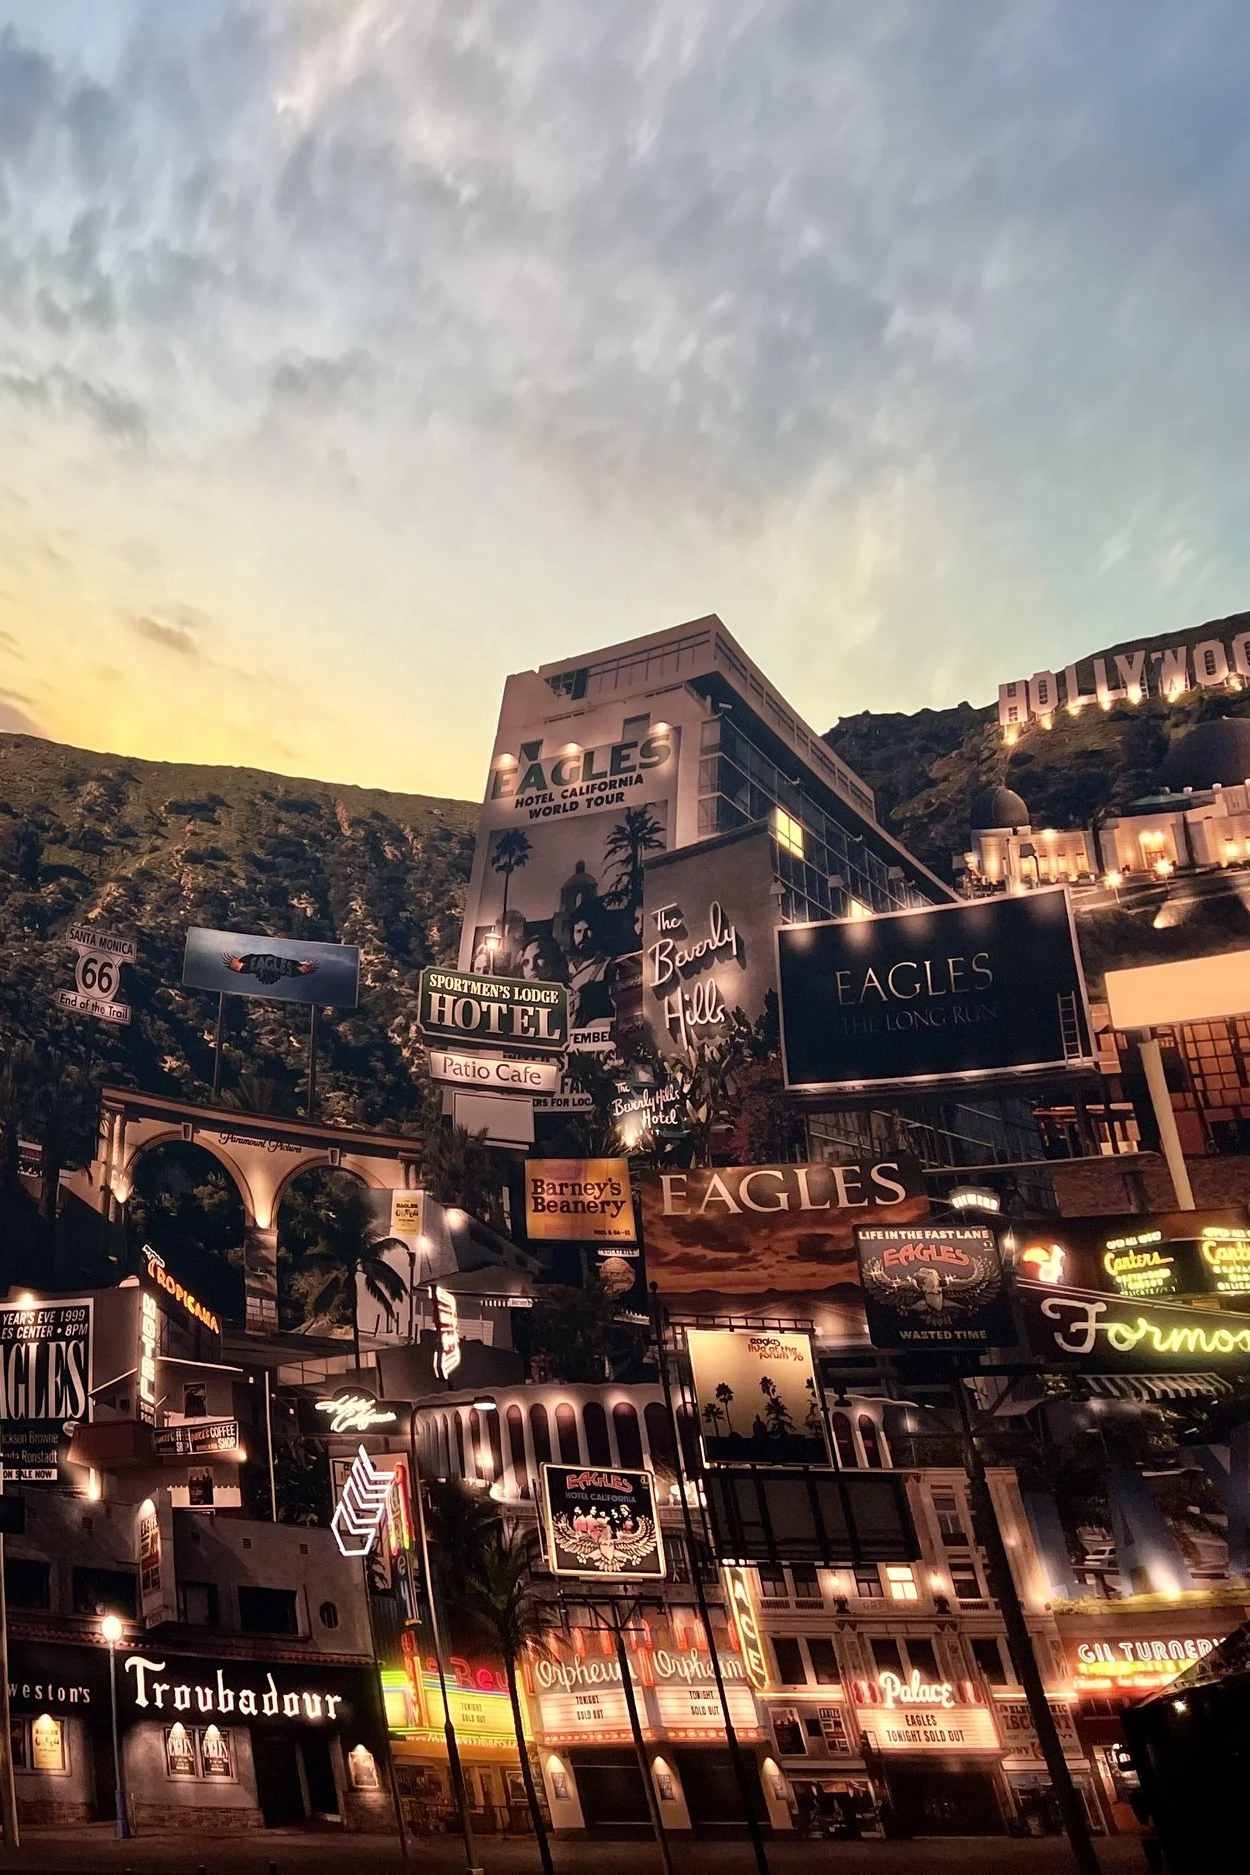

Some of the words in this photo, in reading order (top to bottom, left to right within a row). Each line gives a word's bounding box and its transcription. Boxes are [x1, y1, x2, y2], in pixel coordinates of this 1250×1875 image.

[491, 733, 672, 800] EAGLES
[515, 791, 555, 809] HOTEL
[560, 773, 645, 798] CALIFORNIA
[529, 801, 579, 820] WORLD
[585, 791, 625, 809] TOUR
[650, 902, 682, 932] The
[68, 927, 97, 947] SANTA
[98, 935, 134, 957] MONICA
[648, 900, 738, 988] Beverly
[81, 957, 113, 994] 66
[249, 955, 294, 977] EAGLES
[429, 973, 511, 1000] SPORTMEN'S
[513, 986, 559, 1005] LODGE
[835, 952, 995, 1006] EAGLES
[59, 992, 78, 1008] End
[79, 997, 90, 1011] of
[91, 999, 106, 1016] the
[107, 1003, 130, 1021] Trail
[426, 990, 562, 1041] HOTEL
[664, 977, 727, 1051] Hills
[886, 1008, 947, 1032] LONG
[953, 1001, 998, 1025] RUN
[442, 1056, 491, 1080] Patio
[495, 1062, 543, 1086] Cafe
[614, 1081, 631, 1094] The
[550, 1097, 570, 1107] FOR
[611, 1088, 656, 1118] Beverly
[655, 1086, 681, 1109] Hills
[642, 1109, 679, 1130] Hotel
[218, 1131, 267, 1150] Paramount
[267, 1138, 303, 1154] Pictures
[531, 1177, 623, 1200] Barney's
[659, 1163, 907, 1217] EAGLES
[531, 1195, 627, 1219] Beanery
[858, 1230, 884, 1241] LIFE
[885, 1230, 897, 1240] IN
[898, 1230, 923, 1240] THE
[924, 1229, 954, 1240] FAST
[956, 1229, 990, 1239] LANE
[883, 1242, 971, 1268] EAGLES
[147, 1257, 220, 1335] TROPICANA
[2, 1312, 35, 1326] YEAR'S
[37, 1310, 56, 1324] EVE
[59, 1308, 86, 1323] 1999
[15, 1324, 54, 1340] CENTER
[64, 1323, 89, 1337] 8PM
[750, 1337, 781, 1347] eagles
[899, 1329, 953, 1341] WASTED
[954, 1329, 988, 1340] TIME
[28, 1430, 59, 1445] Browne
[209, 1424, 235, 1439] COFFEE
[217, 1436, 235, 1450] SHOP
[21, 1449, 58, 1464] Ronstadt
[2, 1470, 13, 1479] ON
[15, 1470, 33, 1479] SALE
[34, 1469, 53, 1478] NOW
[565, 1471, 634, 1494] EAGLES
[565, 1491, 588, 1501] HOTEL
[590, 1493, 637, 1504] CALIFORNIA
[1077, 1642, 1116, 1664] GIL
[1118, 1637, 1226, 1662] TURNER'
[7, 1681, 91, 1704] weston's
[124, 1655, 343, 1721] Troubadour
[878, 1668, 956, 1710] Palace
[461, 1713, 474, 1723] SOLD
[475, 1713, 486, 1724] OUT
[576, 1710, 592, 1720] SOLD
[690, 1705, 706, 1717] SOLD
[707, 1705, 720, 1716] OUT
[904, 1713, 938, 1727] EAGLES
[886, 1729, 923, 1743] TONIGHT
[923, 1729, 947, 1743] SOLD
[948, 1729, 966, 1743] OUT
